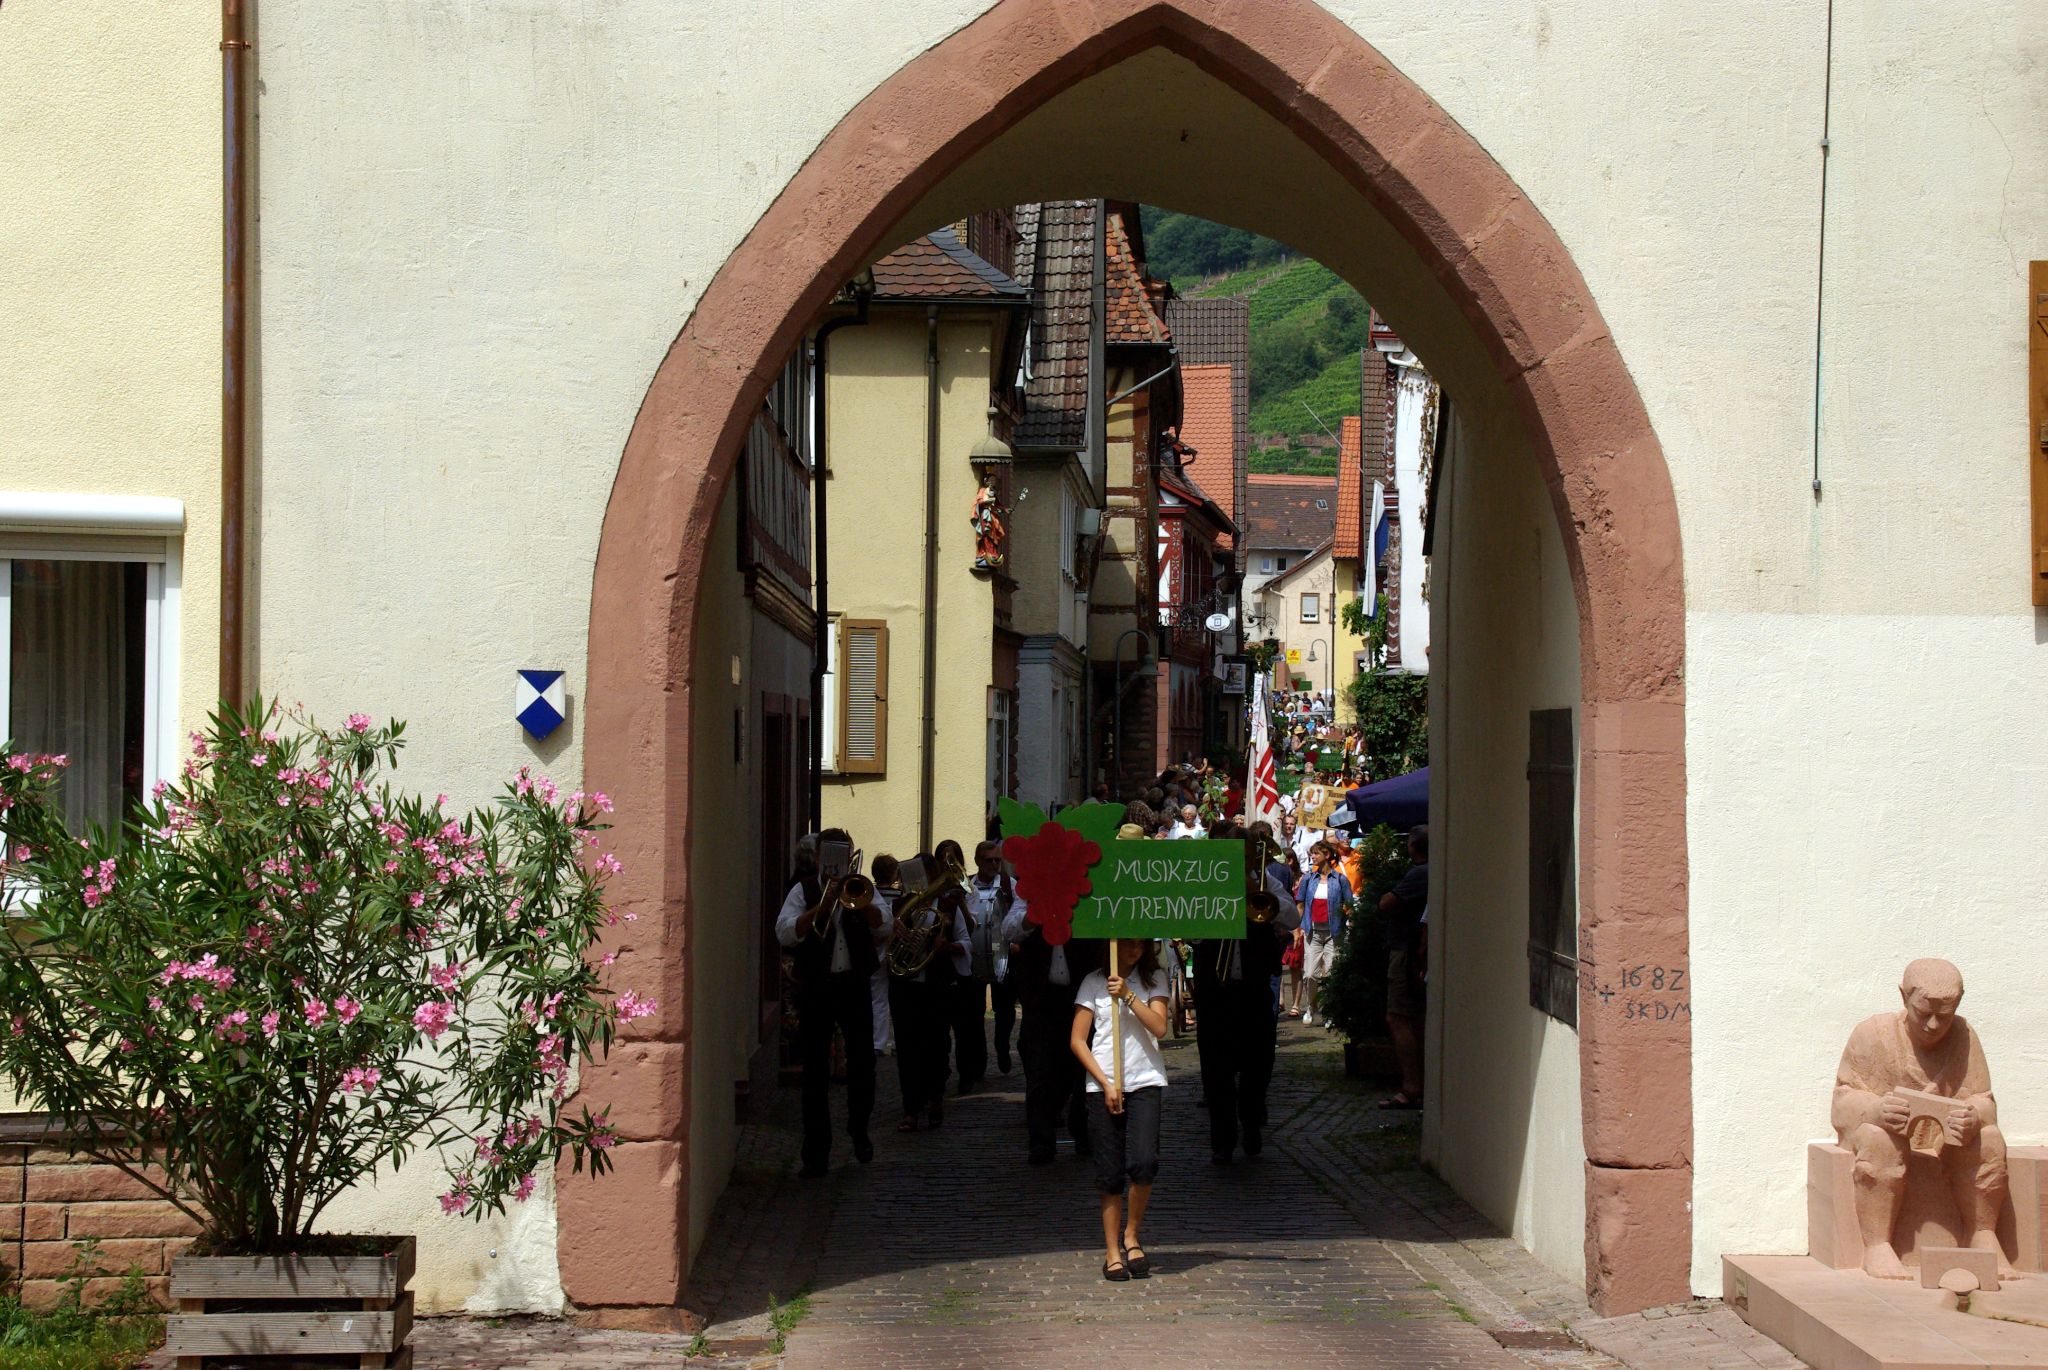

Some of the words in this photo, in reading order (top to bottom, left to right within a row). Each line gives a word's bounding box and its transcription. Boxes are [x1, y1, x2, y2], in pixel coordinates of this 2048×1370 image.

[1113, 859, 1230, 883] MUSIKZUG
[1090, 896, 1124, 919] TV
[1125, 896, 1245, 921] TRENNFURT
